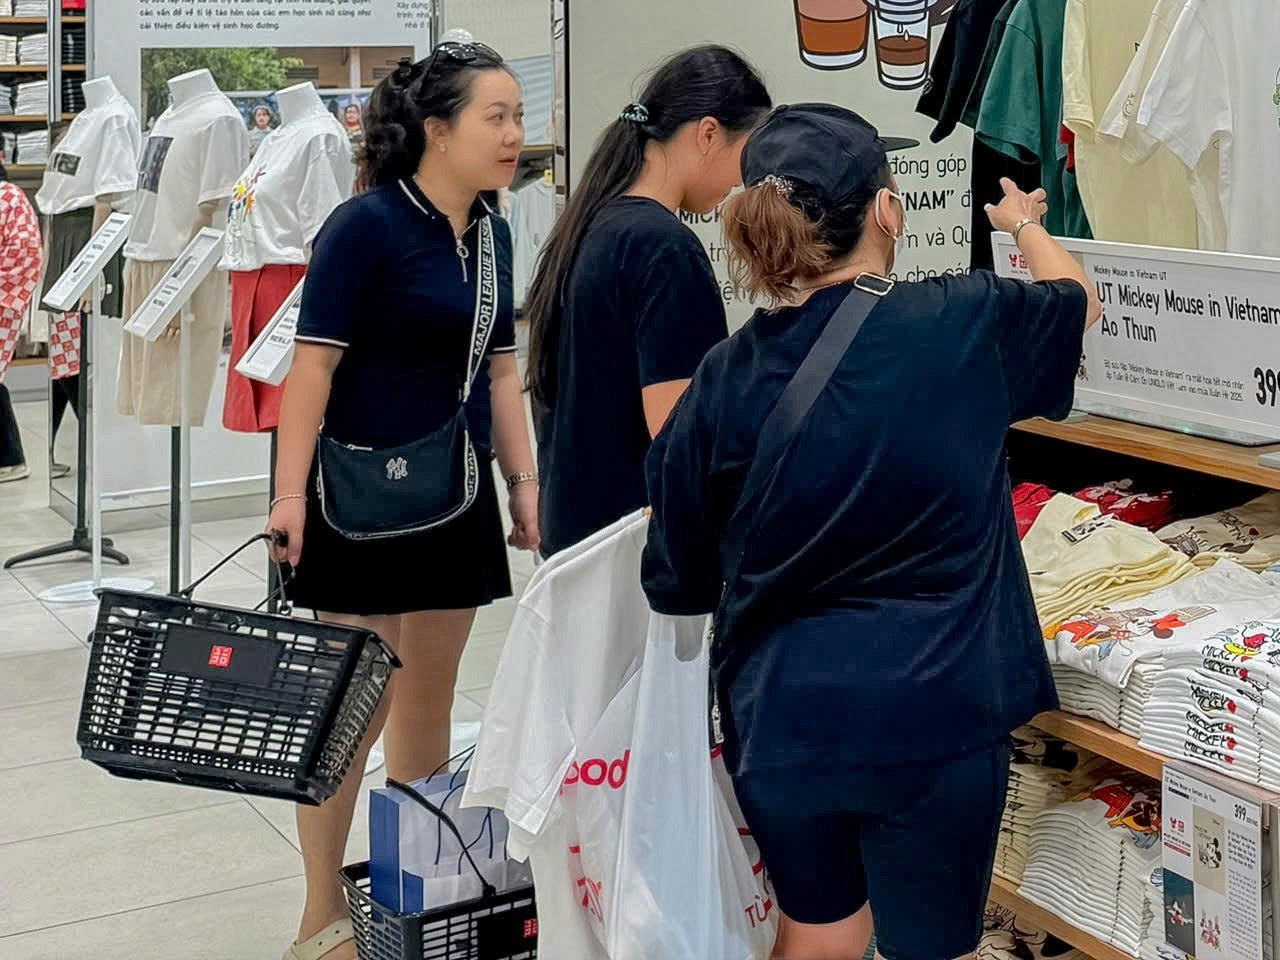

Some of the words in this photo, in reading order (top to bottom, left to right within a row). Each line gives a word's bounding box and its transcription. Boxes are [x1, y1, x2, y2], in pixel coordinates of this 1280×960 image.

[937, 153, 967, 177] góp
[926, 226, 945, 247] và
[482, 254, 494, 305] LEAGUE
[1096, 281, 1114, 304] UT
[1118, 284, 1160, 316] Mickey
[1165, 288, 1204, 316] Mouse
[1209, 293, 1222, 318] in
[474, 304, 493, 356] MAJOR
[1100, 307, 1118, 337] Áo
[1122, 315, 1157, 343] Thun
[1234, 803, 1247, 822] 399
